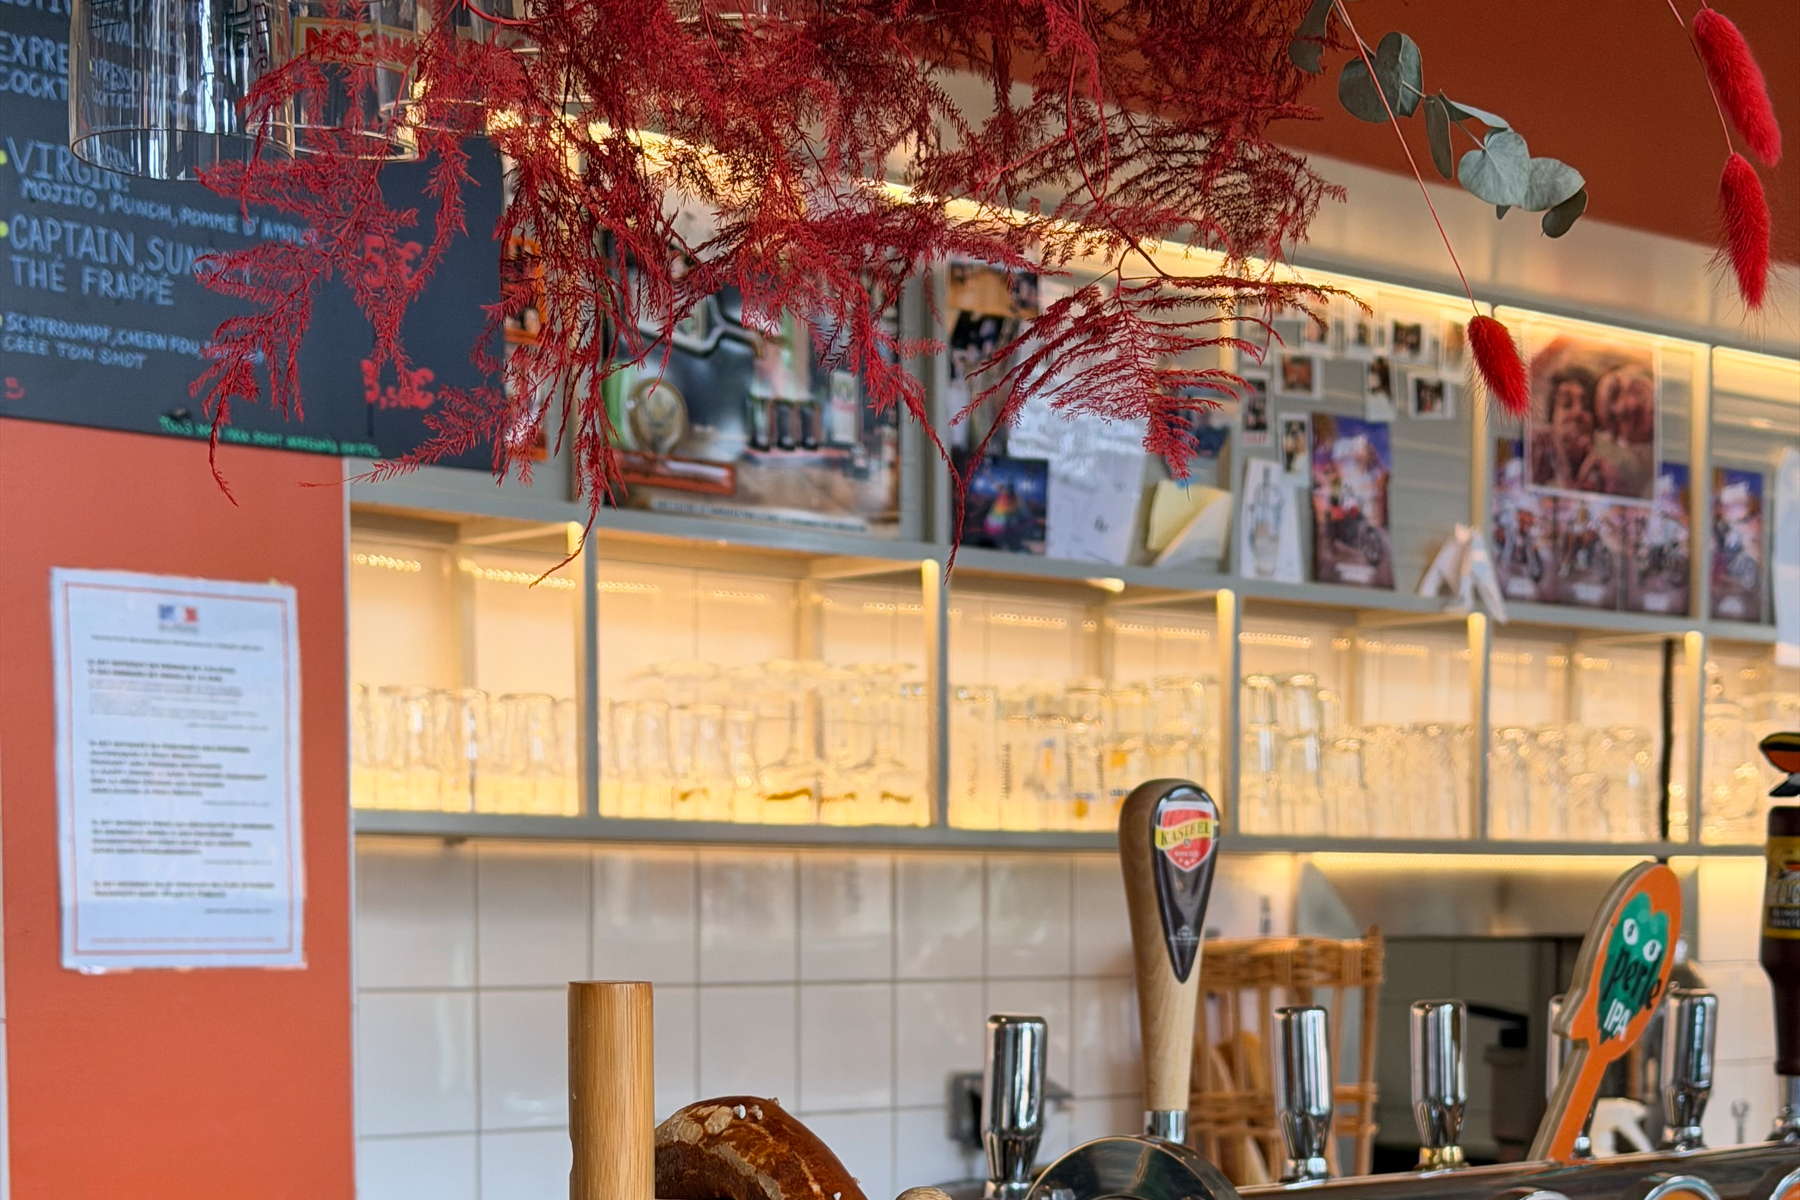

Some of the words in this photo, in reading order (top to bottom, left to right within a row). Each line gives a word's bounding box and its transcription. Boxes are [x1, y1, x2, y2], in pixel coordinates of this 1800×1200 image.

[10, 252, 67, 293] THÉ
[82, 264, 174, 306] FRAPPÉ
[54, 341, 95, 360] TON
[1160, 820, 1212, 847] KASTEEL
[1603, 998, 1632, 1042] IPA
